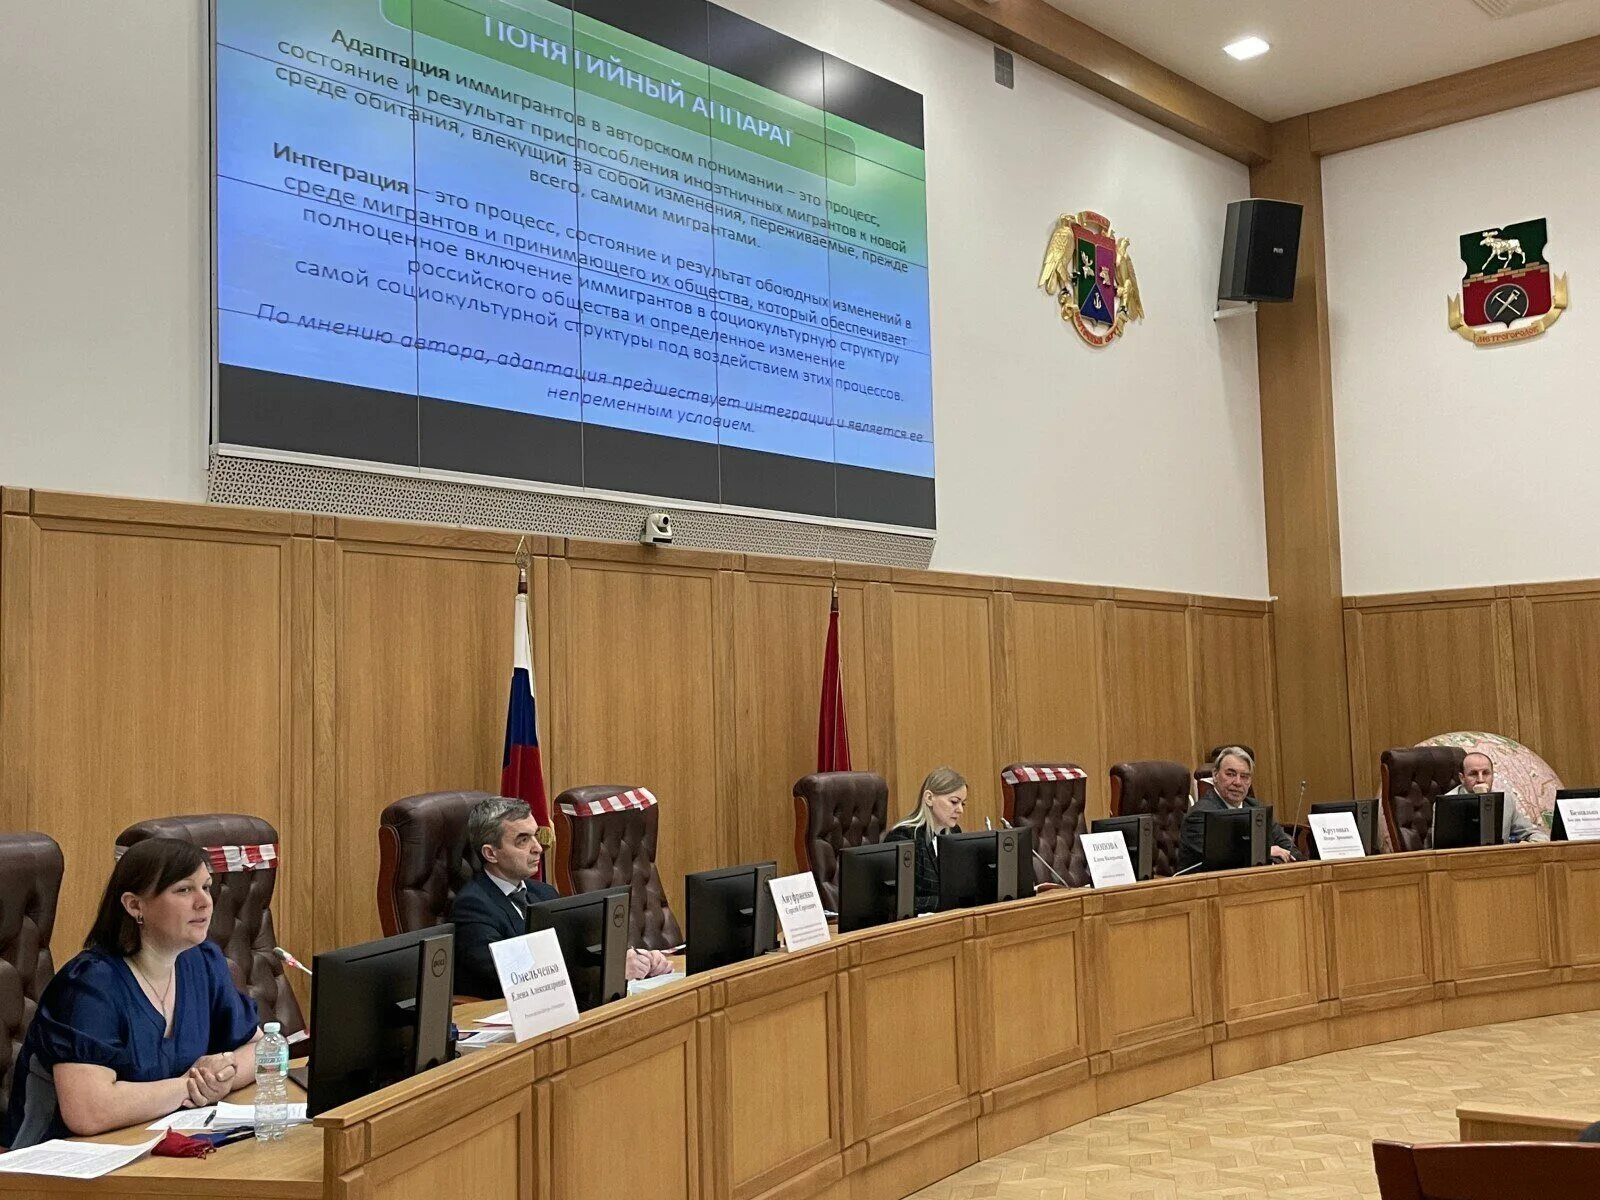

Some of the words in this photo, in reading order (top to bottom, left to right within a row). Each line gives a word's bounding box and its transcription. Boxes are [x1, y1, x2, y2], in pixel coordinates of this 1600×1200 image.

[277, 40, 398, 90] состояние
[407, 82, 419, 97] и
[427, 89, 525, 131] результат
[531, 122, 679, 182] приспособления
[684, 173, 783, 214] иноэтничных
[787, 206, 856, 240] мигрантов
[860, 230, 868, 241] к
[870, 233, 907, 254] новой
[331, 29, 451, 81] Адаптация
[455, 75, 585, 127] иммигрантов
[592, 120, 601, 132] в
[606, 126, 693, 163] авторском
[698, 156, 783, 195] понимании
[800, 189, 820, 206] это
[825, 197, 880, 228] процесс,
[484, 16, 686, 108] ПОНЯТИЙНЫЙ
[692, 96, 793, 148] АППАРАТ
[273, 142, 409, 194] Интеграция
[435, 190, 468, 210] это
[476, 199, 560, 235] процесс,
[565, 226, 656, 261] состояние
[662, 254, 671, 265] и
[676, 258, 751, 287] результат
[755, 279, 829, 308] обоюдных
[833, 299, 901, 326] изменений
[905, 318, 912, 329] в
[276, 66, 346, 102] среде
[355, 89, 464, 138] обитания,
[472, 128, 566, 167] влекущий
[573, 159, 592, 175] за
[597, 165, 649, 193] собой
[655, 184, 745, 225] изменения,
[750, 216, 858, 259] переживаемые,
[862, 250, 908, 273] прежде
[530, 169, 584, 198] всего,
[591, 187, 658, 217] самими
[662, 211, 761, 248] мигрантами.
[284, 175, 355, 207] среде
[363, 195, 478, 236] мигрантов
[485, 228, 496, 241] и
[503, 233, 646, 281] принимающего
[651, 270, 670, 286] их
[674, 277, 752, 310] общества,
[757, 298, 817, 324] который
[821, 315, 907, 347] обеспечивает
[295, 259, 369, 288] самой
[377, 277, 558, 329] социокультурной
[564, 319, 653, 349] структуры
[658, 338, 689, 358] под
[693, 348, 799, 381] воздействием
[803, 371, 832, 387] этих
[835, 377, 904, 403] процессов.
[303, 207, 458, 257] полноценное
[465, 248, 572, 285] включение
[579, 276, 692, 314] иммигрантов
[697, 305, 705, 318] в
[710, 308, 837, 349] социокультурную
[840, 341, 899, 366] структуру
[408, 259, 536, 299] российского
[542, 289, 630, 322] общества
[636, 313, 645, 324] и
[650, 315, 765, 352] определенное
[768, 343, 845, 371] изменение
[256, 303, 290, 324] По
[297, 314, 393, 344] мнению
[400, 334, 491, 365] автора,
[497, 351, 607, 385] адаптация
[612, 373, 741, 409] предшествует
[745, 398, 833, 428] интеграции
[836, 416, 845, 428] и
[848, 418, 907, 440] является
[909, 431, 923, 443] ее
[547, 385, 673, 419] непременным
[677, 408, 755, 433] условием.
[511, 963, 559, 985] Омельченко
